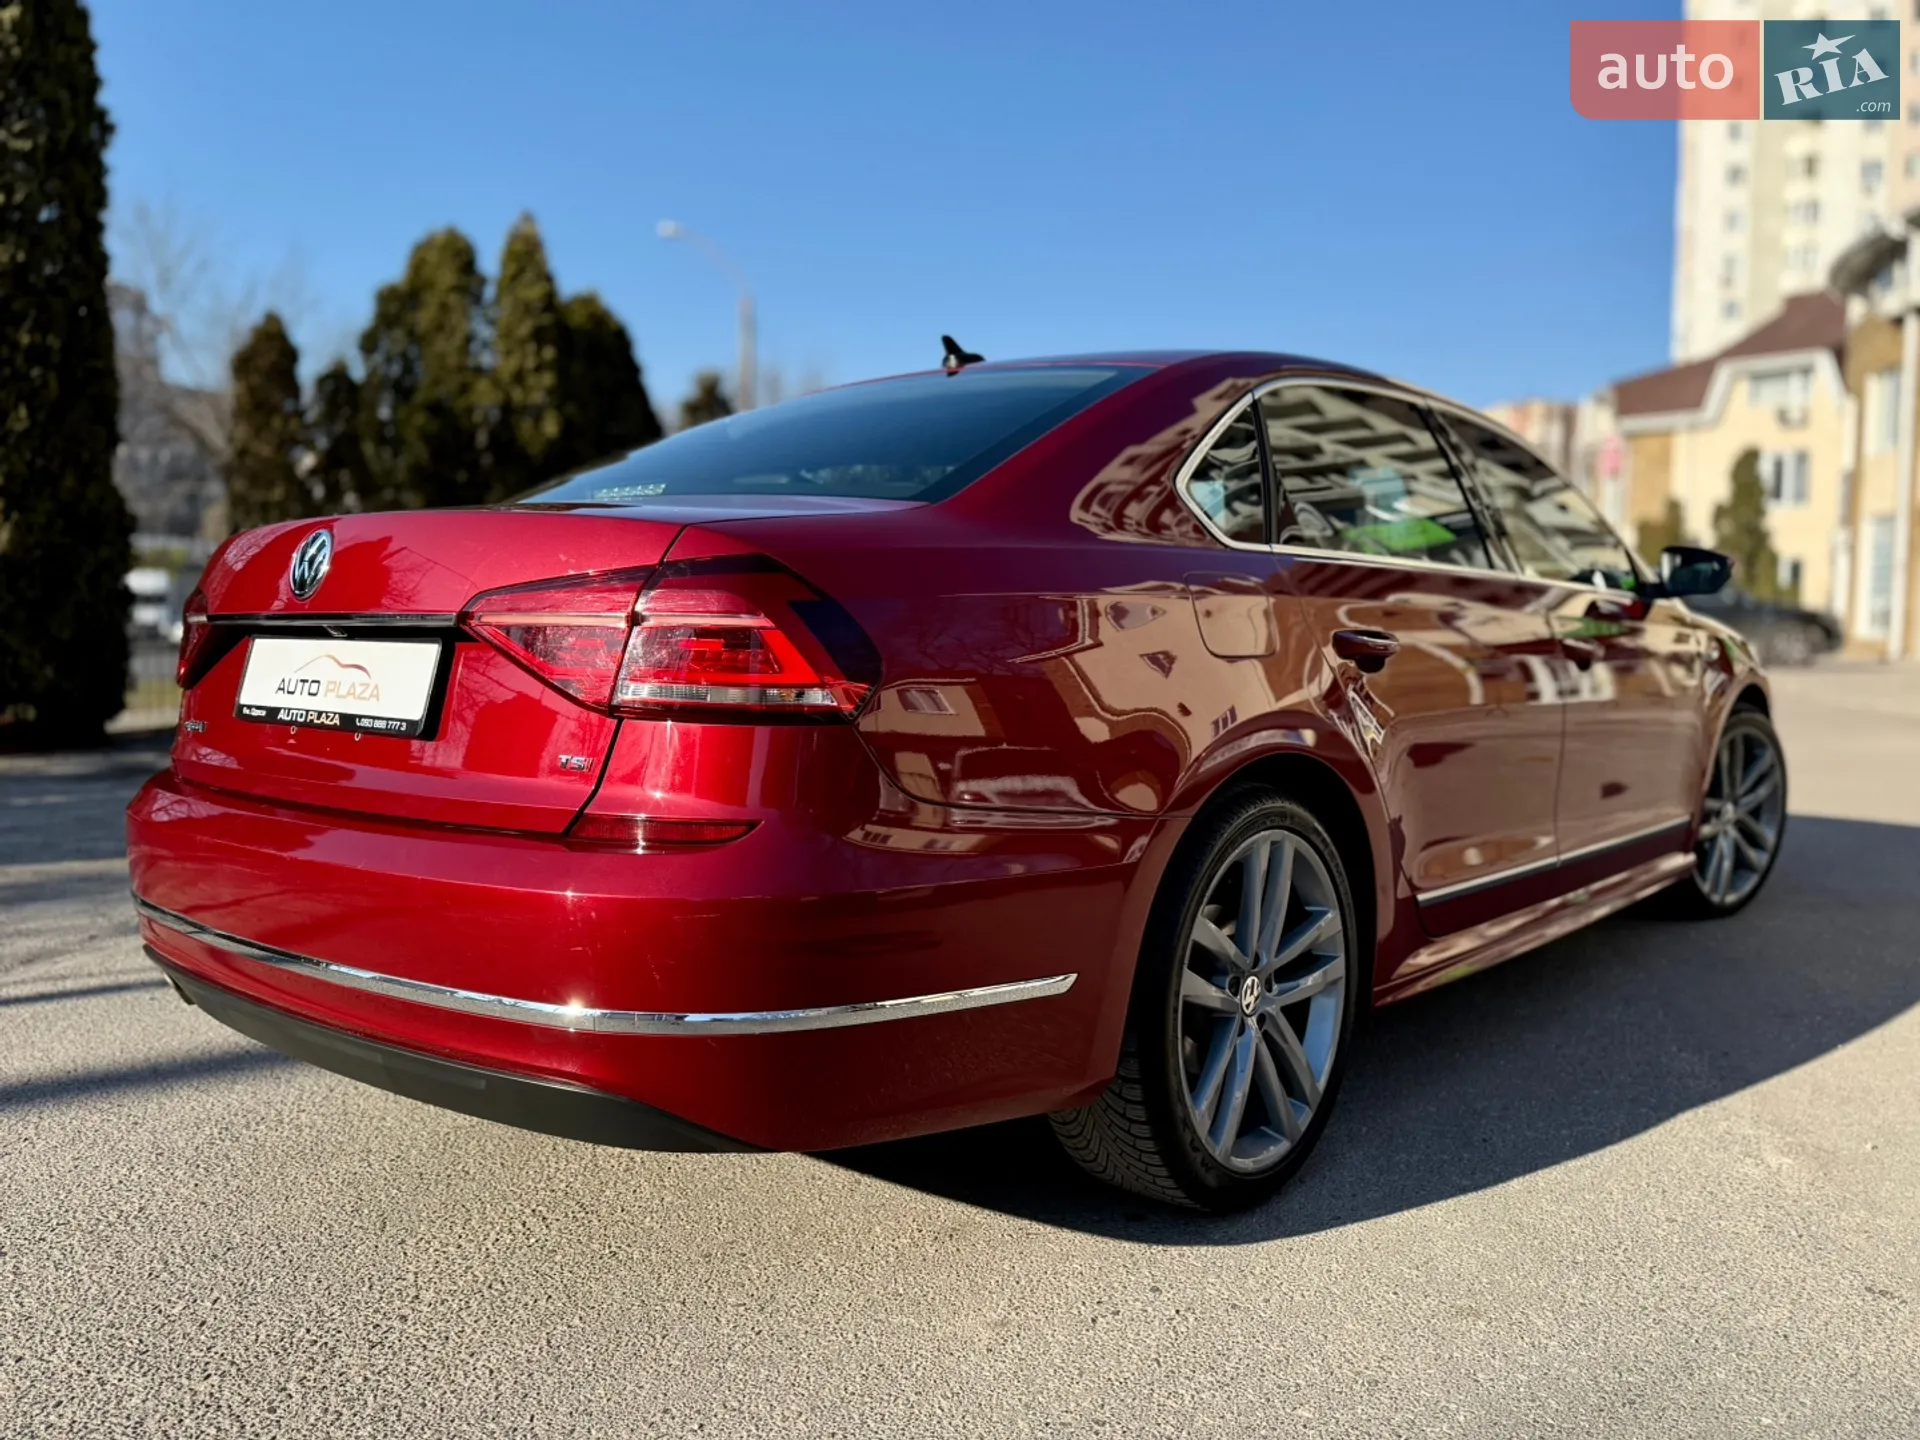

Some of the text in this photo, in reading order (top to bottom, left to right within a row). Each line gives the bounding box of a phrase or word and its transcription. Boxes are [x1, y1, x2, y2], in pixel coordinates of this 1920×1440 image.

[275, 677, 380, 702] AUTO PLAZA
[277, 708, 306, 722] AUTO
[306, 711, 340, 726] PLAZA
